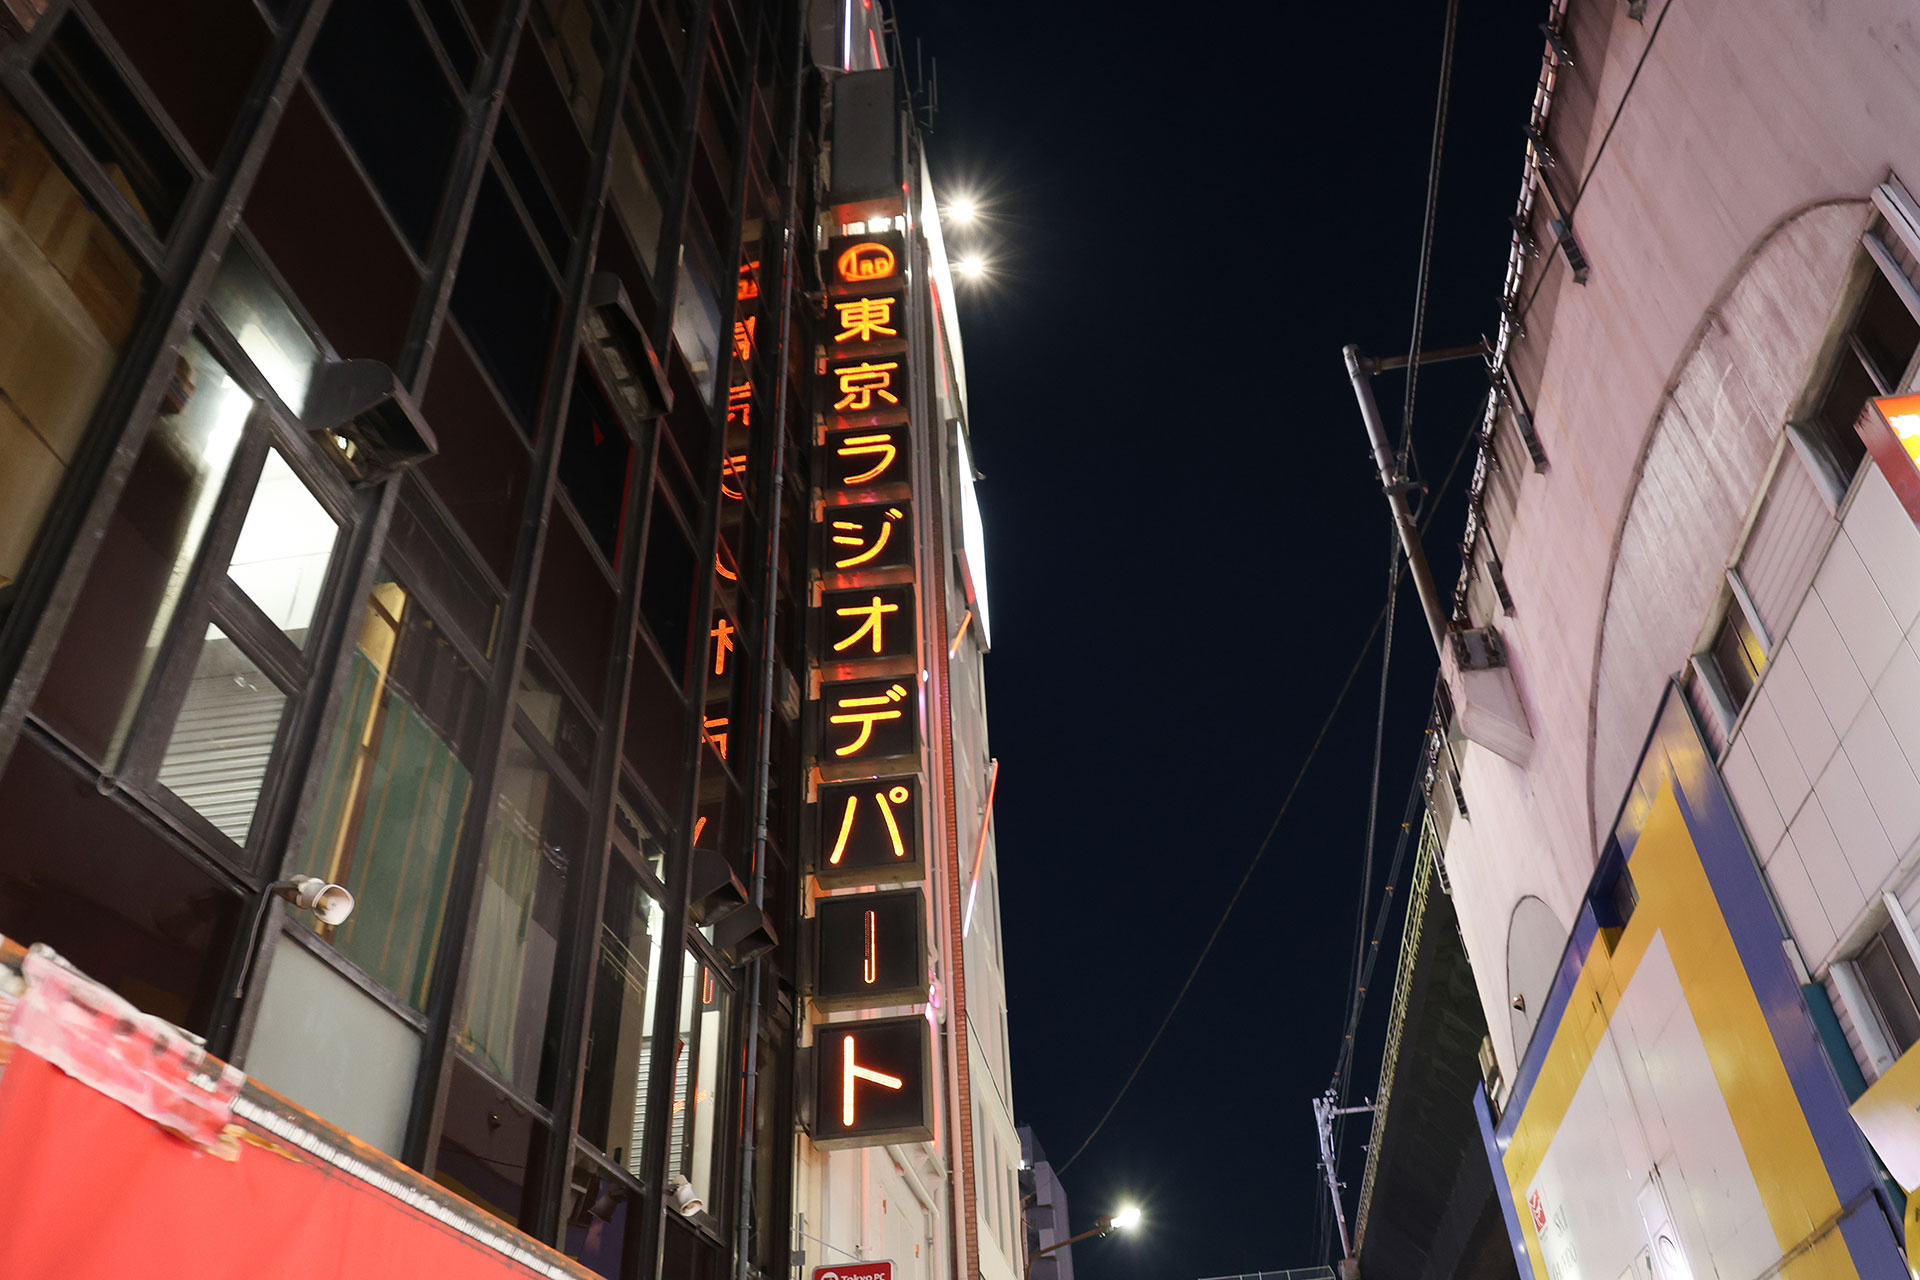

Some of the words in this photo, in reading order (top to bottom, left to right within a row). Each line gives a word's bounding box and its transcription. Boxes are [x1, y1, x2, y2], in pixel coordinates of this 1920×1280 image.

[829, 297, 910, 1127] 東京ラジオデパート
